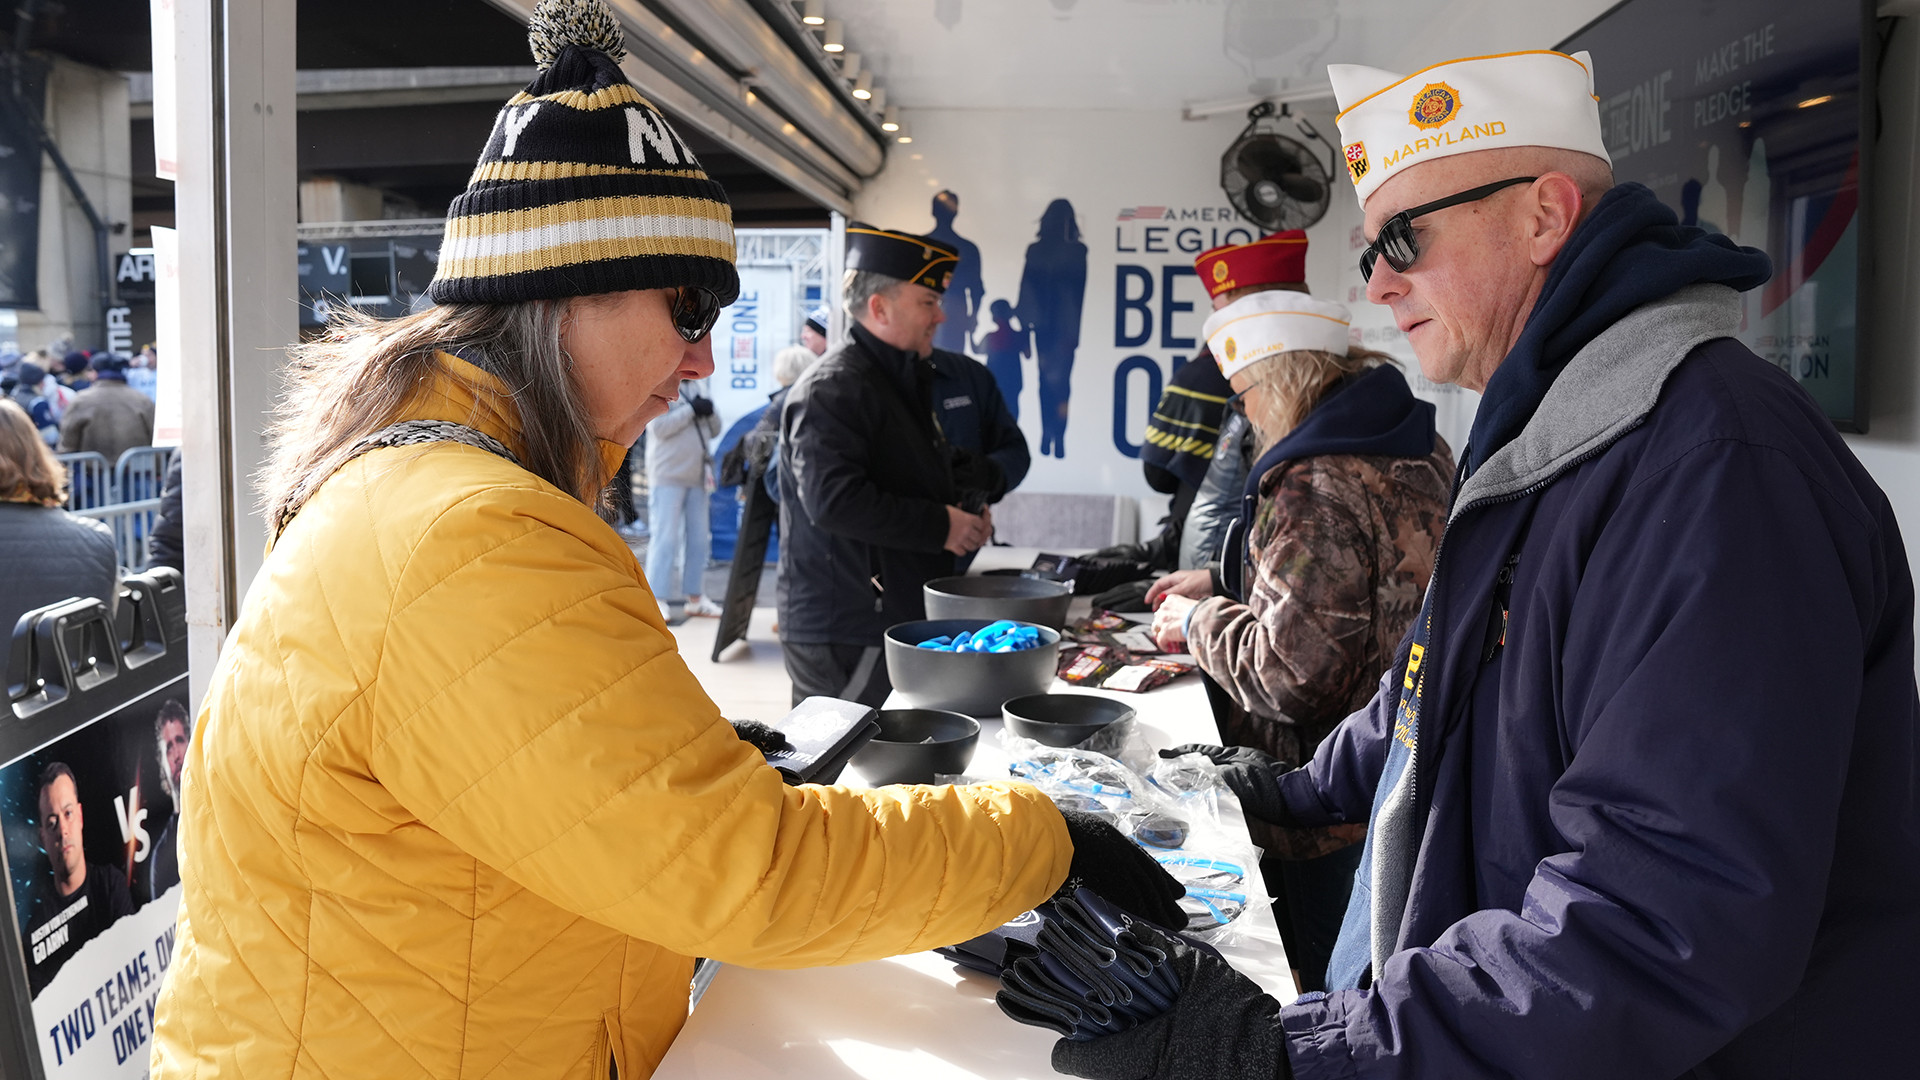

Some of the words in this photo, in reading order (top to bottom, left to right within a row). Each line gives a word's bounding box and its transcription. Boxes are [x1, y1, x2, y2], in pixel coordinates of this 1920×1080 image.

[1695, 40, 1739, 86] MAKE
[1743, 23, 1775, 65] THE
[1631, 69, 1673, 153] ONE
[1693, 80, 1751, 128] PLEDGE
[1383, 120, 1507, 170] MARYLAND
[321, 246, 348, 275] V.
[1117, 227, 1270, 253] LEGIO
[732, 290, 758, 332] ONE
[1114, 264, 1197, 349] BE
[735, 337, 753, 359] THE
[731, 363, 757, 389] BE
[114, 785, 150, 863] VS
[32, 941, 47, 965] GO
[46, 924, 69, 956] ARMY
[50, 998, 96, 1067] TWO
[95, 950, 156, 1026] TEAMS.
[112, 1007, 146, 1066] ONE
